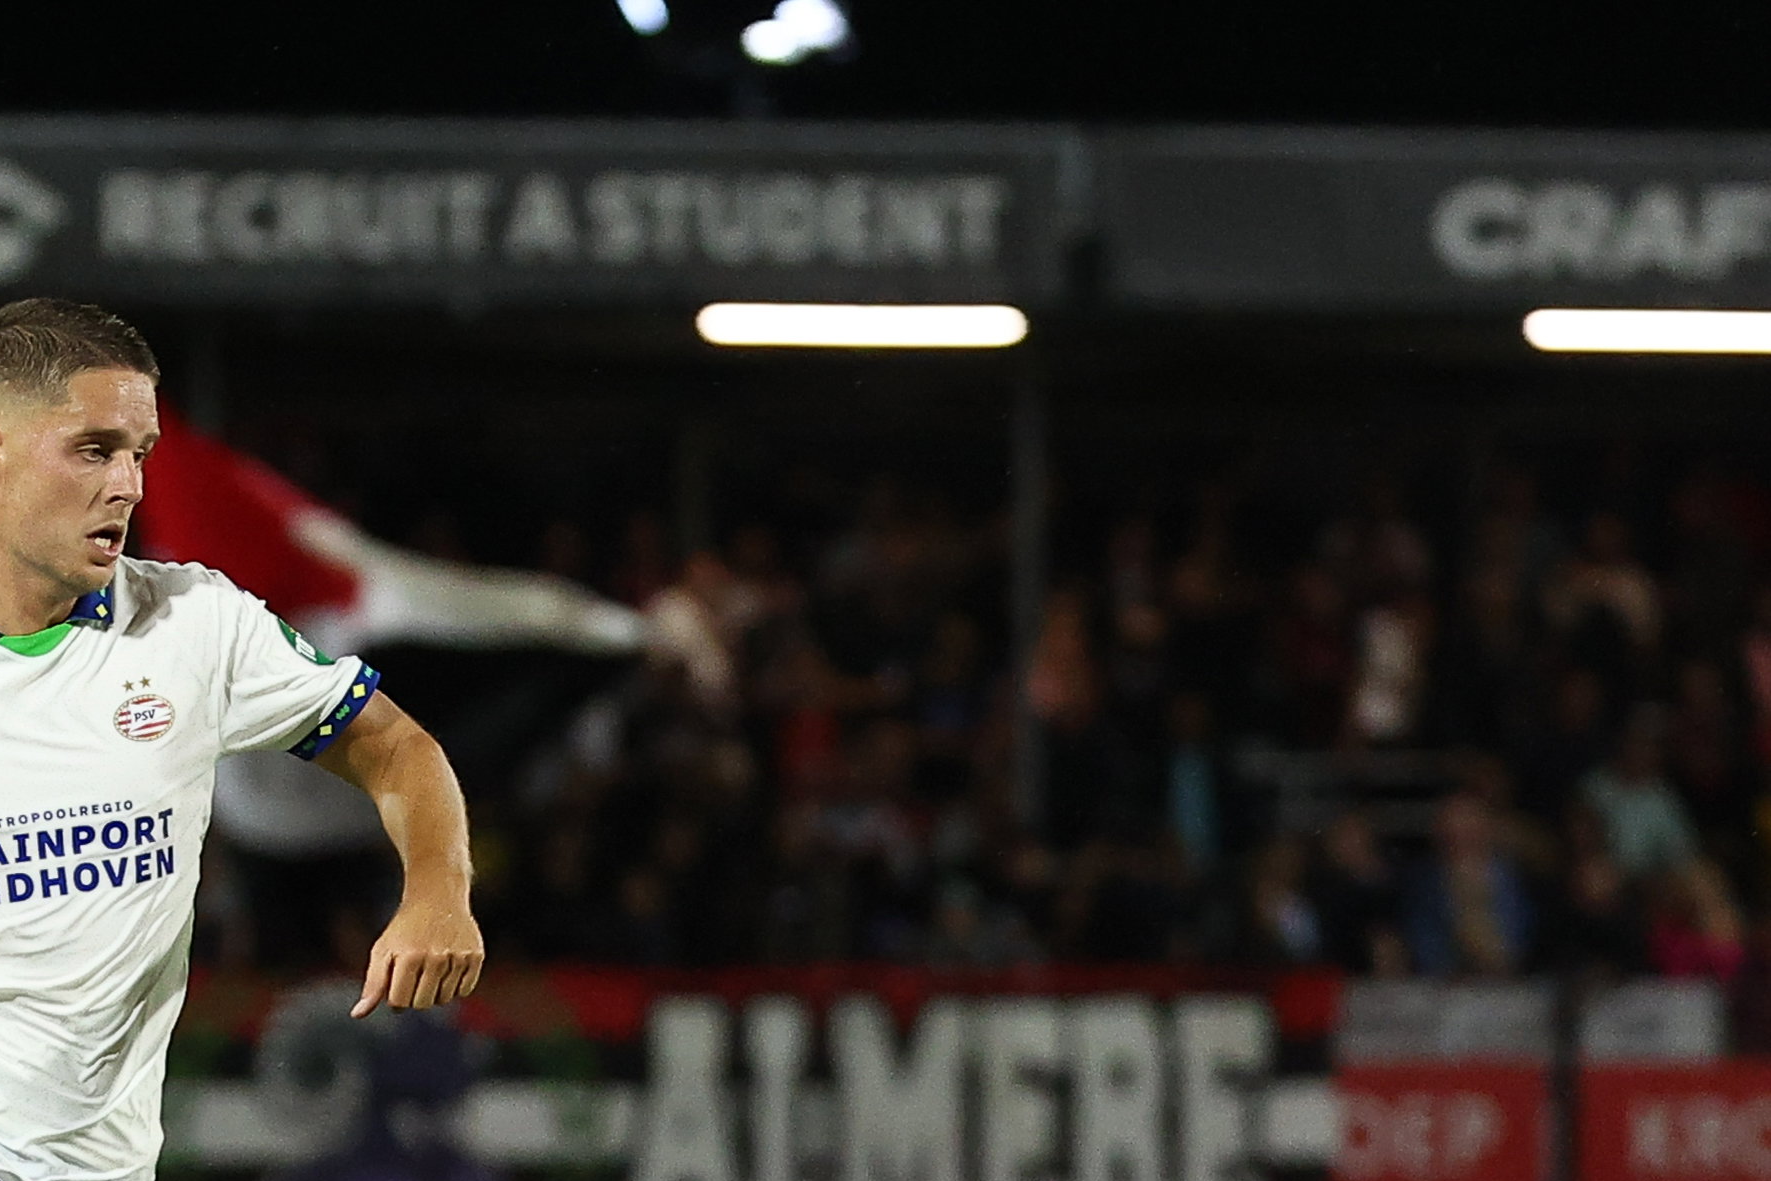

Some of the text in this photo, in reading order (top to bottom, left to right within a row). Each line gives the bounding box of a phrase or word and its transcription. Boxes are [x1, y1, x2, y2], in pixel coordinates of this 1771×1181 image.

[99, 172, 1006, 264] RECRUIT A STUDENT
